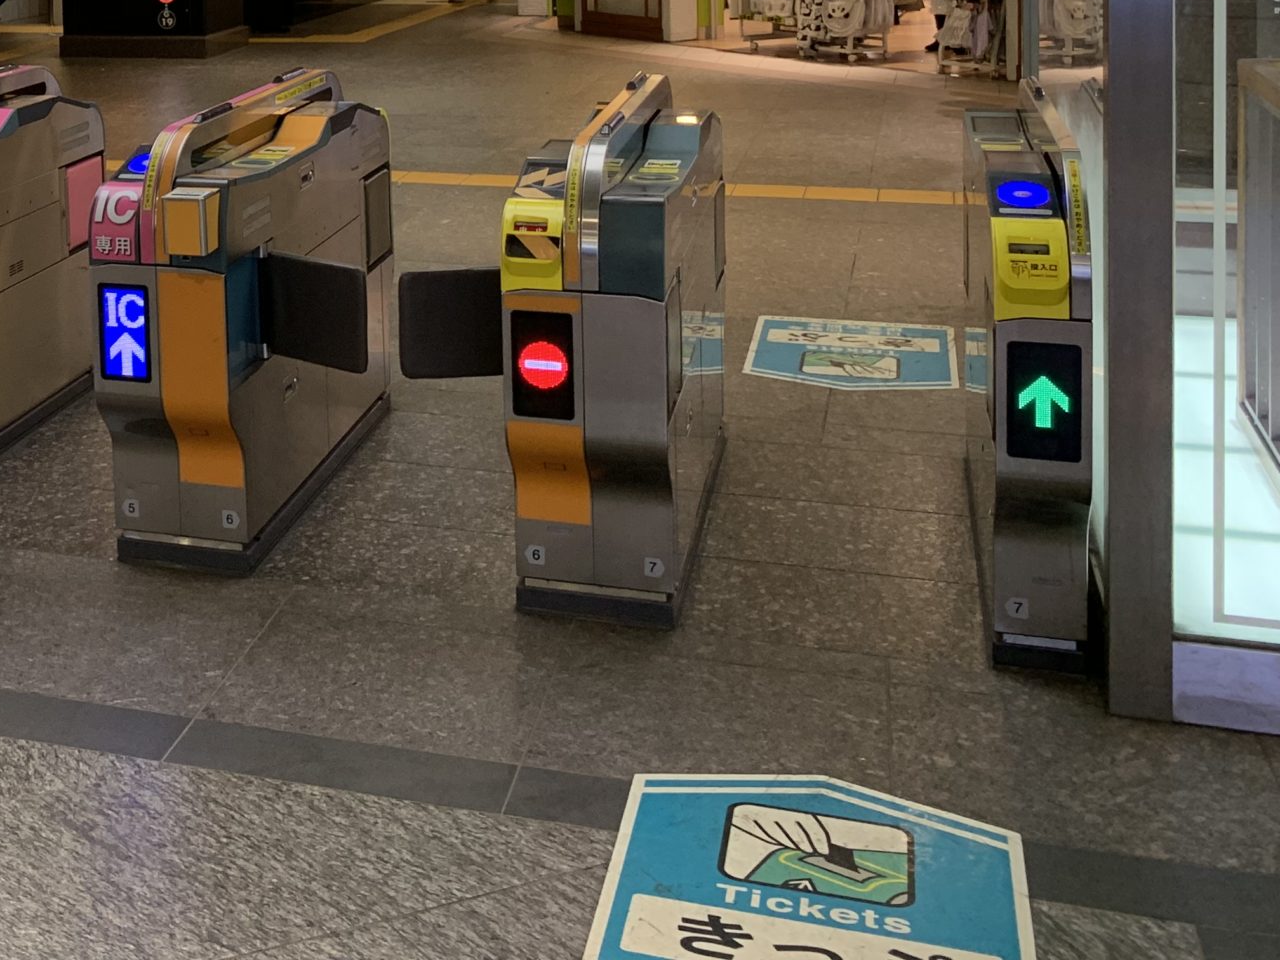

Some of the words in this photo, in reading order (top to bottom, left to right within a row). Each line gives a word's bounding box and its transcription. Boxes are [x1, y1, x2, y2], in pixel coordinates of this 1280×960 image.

[95, 190, 139, 224] IC
[96, 235, 131, 255] 専用
[105, 293, 144, 328] IC
[128, 502, 136, 514] 5
[226, 513, 234, 525] 6
[532, 549, 540, 561] 6
[649, 561, 658, 574] 7
[1014, 602, 1023, 614] 7
[716, 882, 912, 935] Tickets
